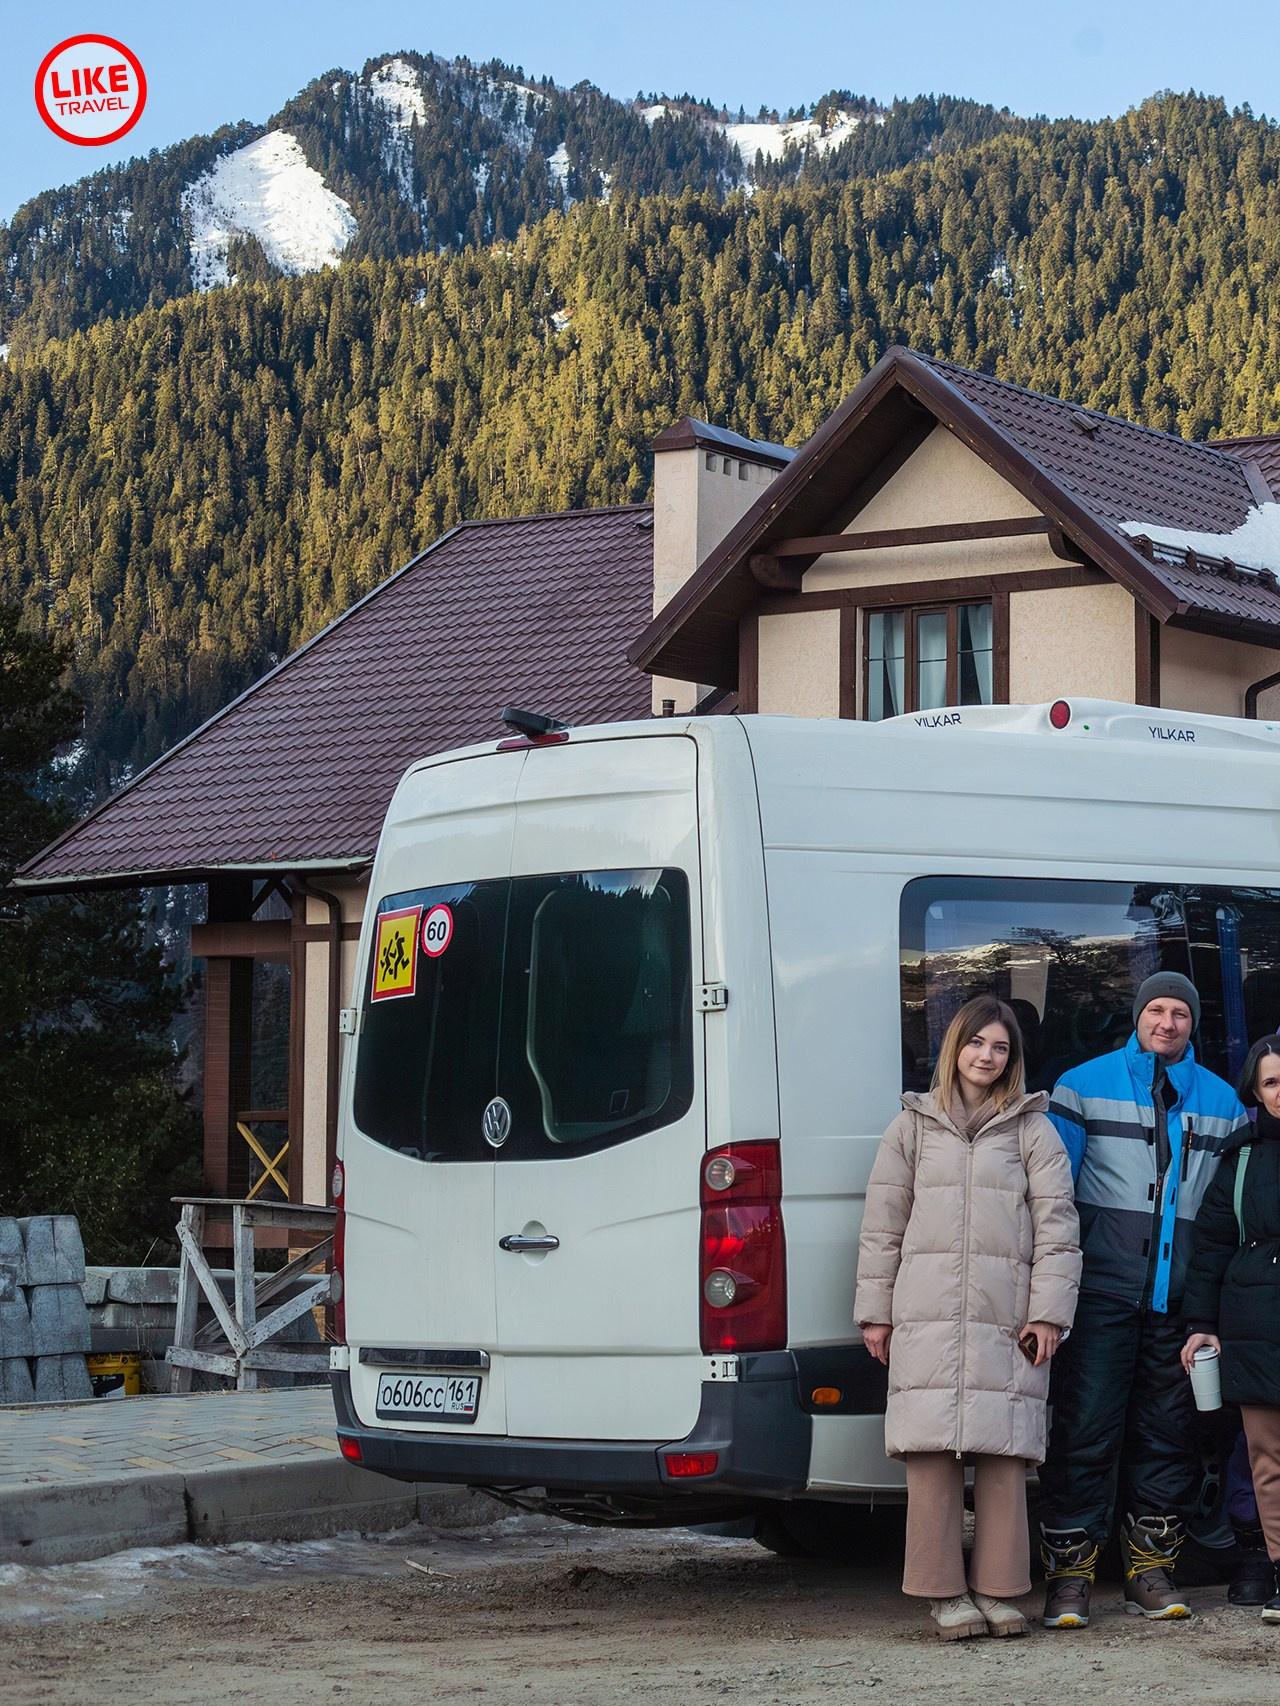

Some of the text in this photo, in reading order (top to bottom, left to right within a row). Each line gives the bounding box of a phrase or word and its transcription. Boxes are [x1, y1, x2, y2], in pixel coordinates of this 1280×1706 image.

[914, 713, 962, 728] YILKAR
[1148, 726, 1196, 743] YILKAR
[427, 921, 447, 941] 60
[448, 1380, 474, 1402] 161
[450, 1402, 464, 1410] RUS
